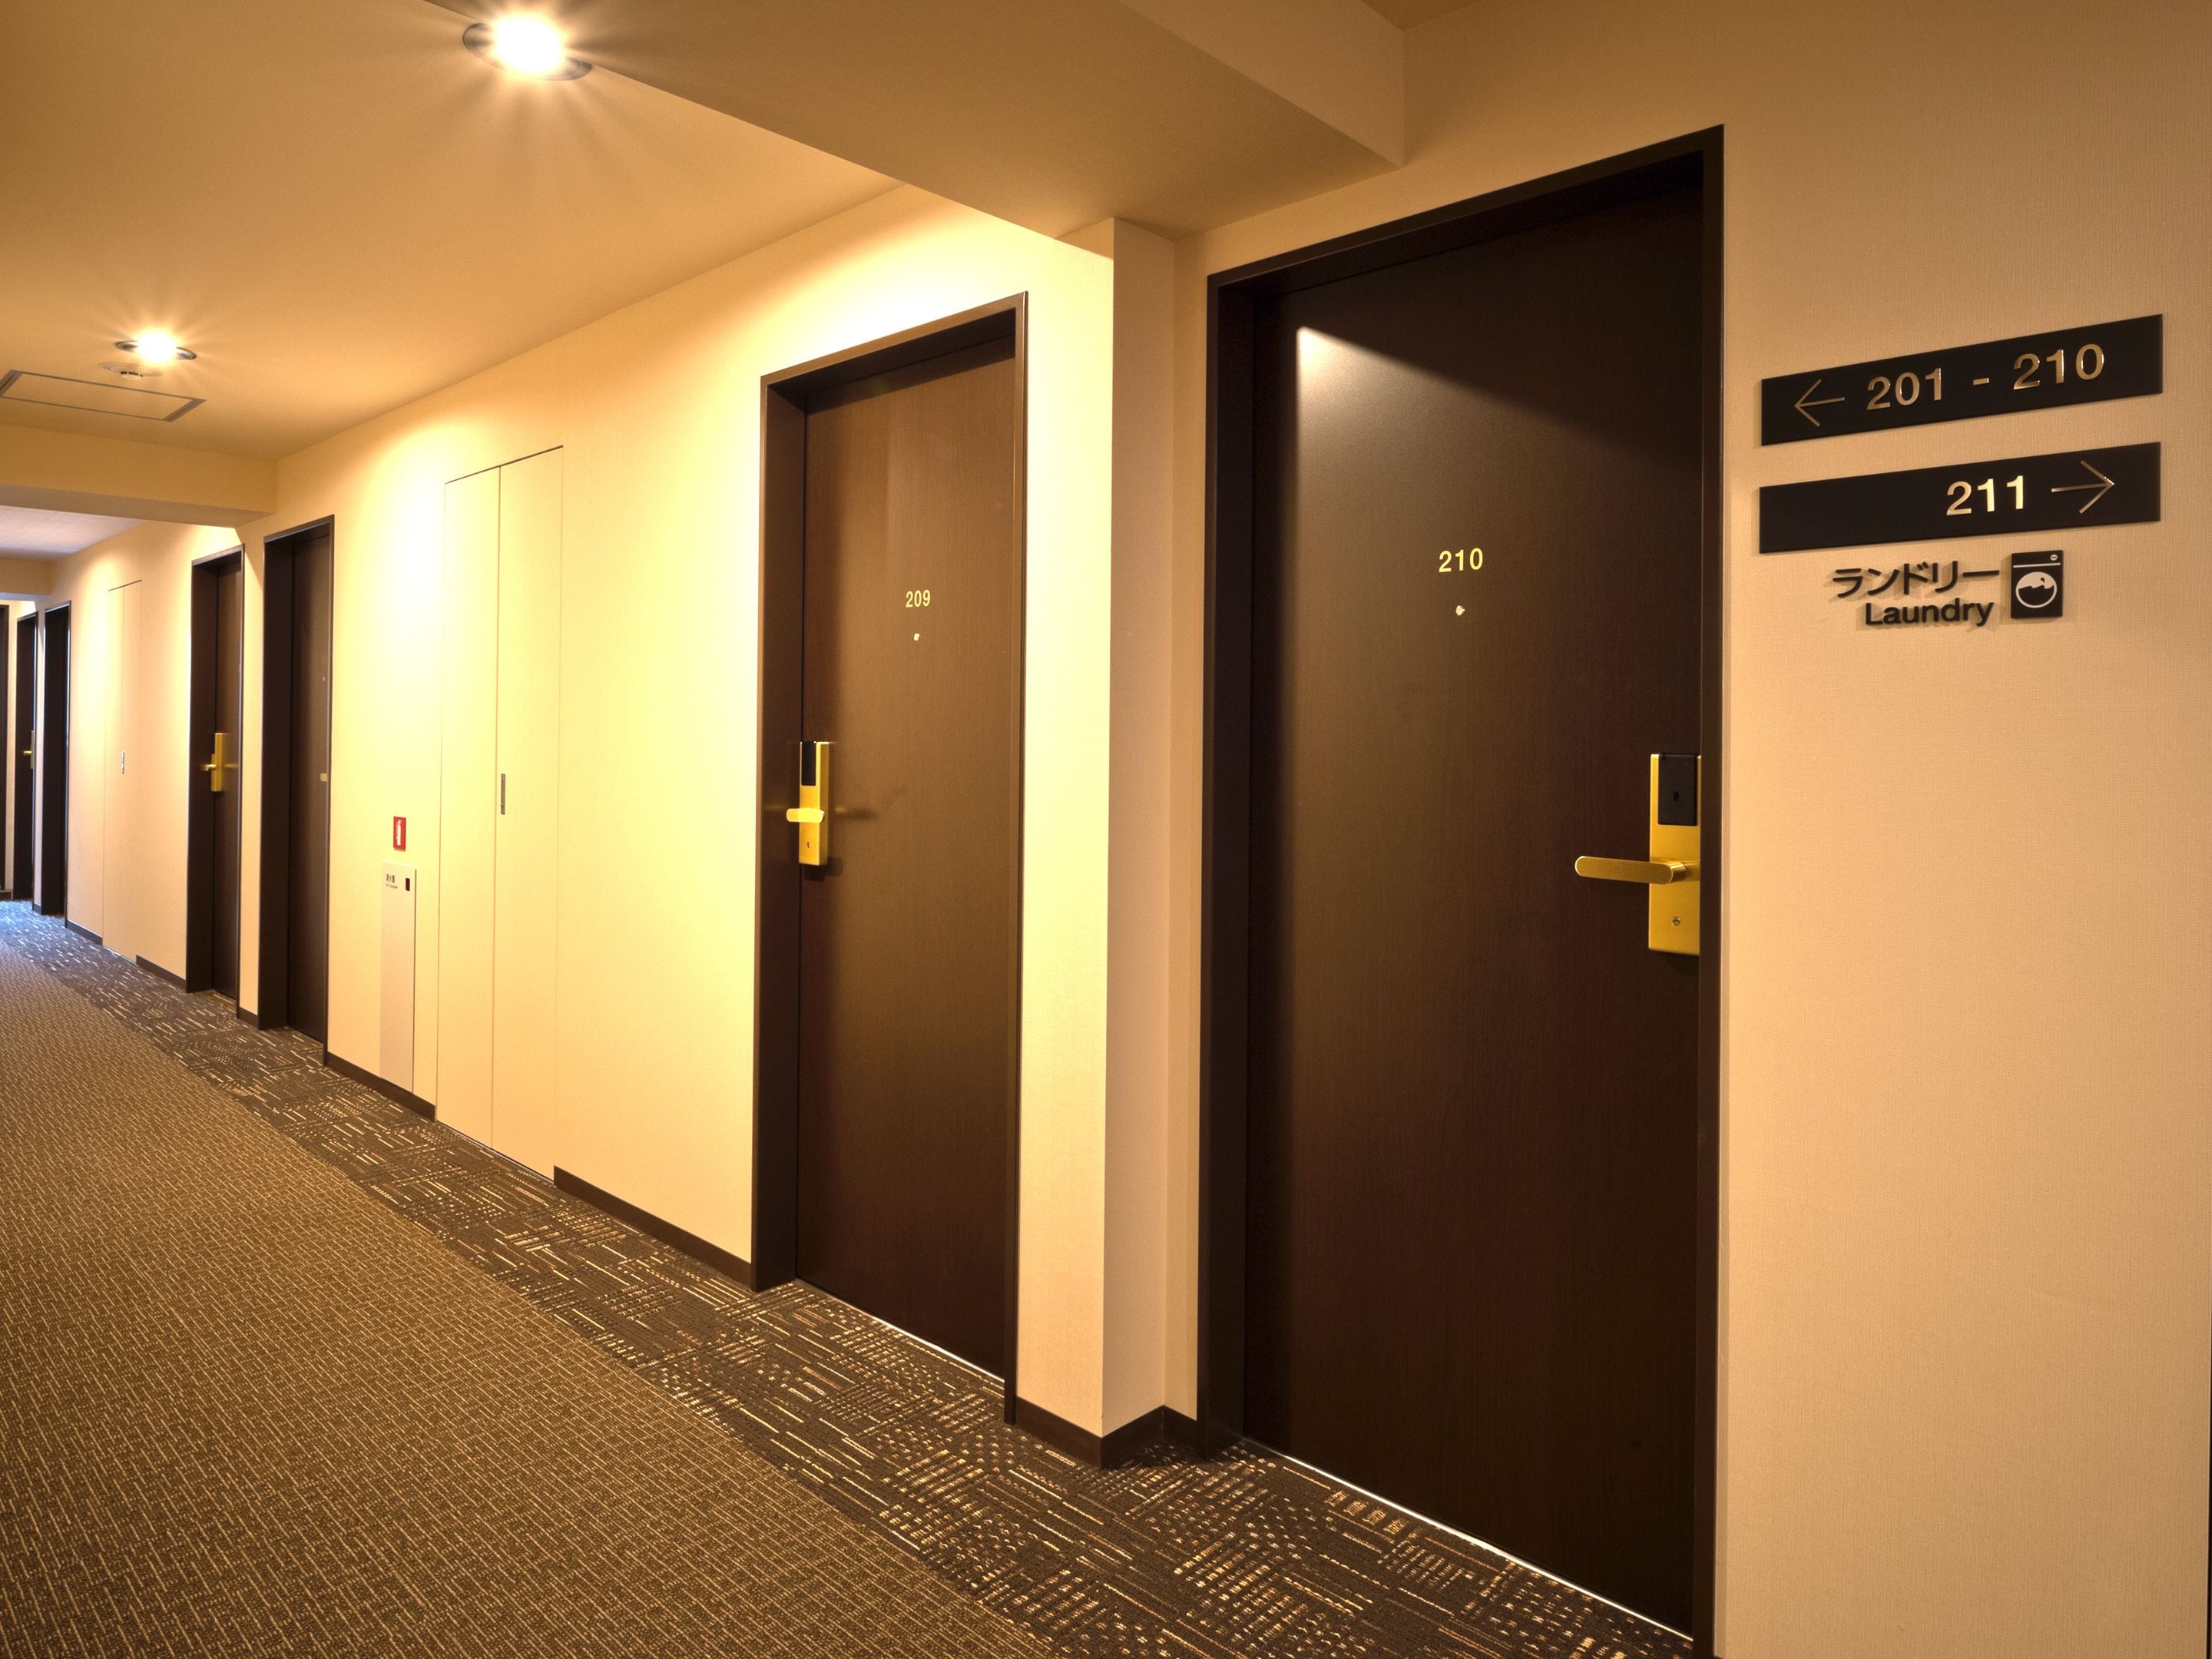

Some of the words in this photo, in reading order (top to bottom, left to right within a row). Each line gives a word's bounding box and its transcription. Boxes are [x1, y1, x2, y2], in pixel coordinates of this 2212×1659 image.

[1867, 367, 1942, 409] 201
[2014, 344, 2104, 389] 210
[1946, 475, 2024, 515] 211
[1439, 548, 1483, 572] 210
[1833, 561, 2000, 598] ランドリー
[906, 589, 930, 608] 209
[1866, 598, 1995, 627] Laundry
